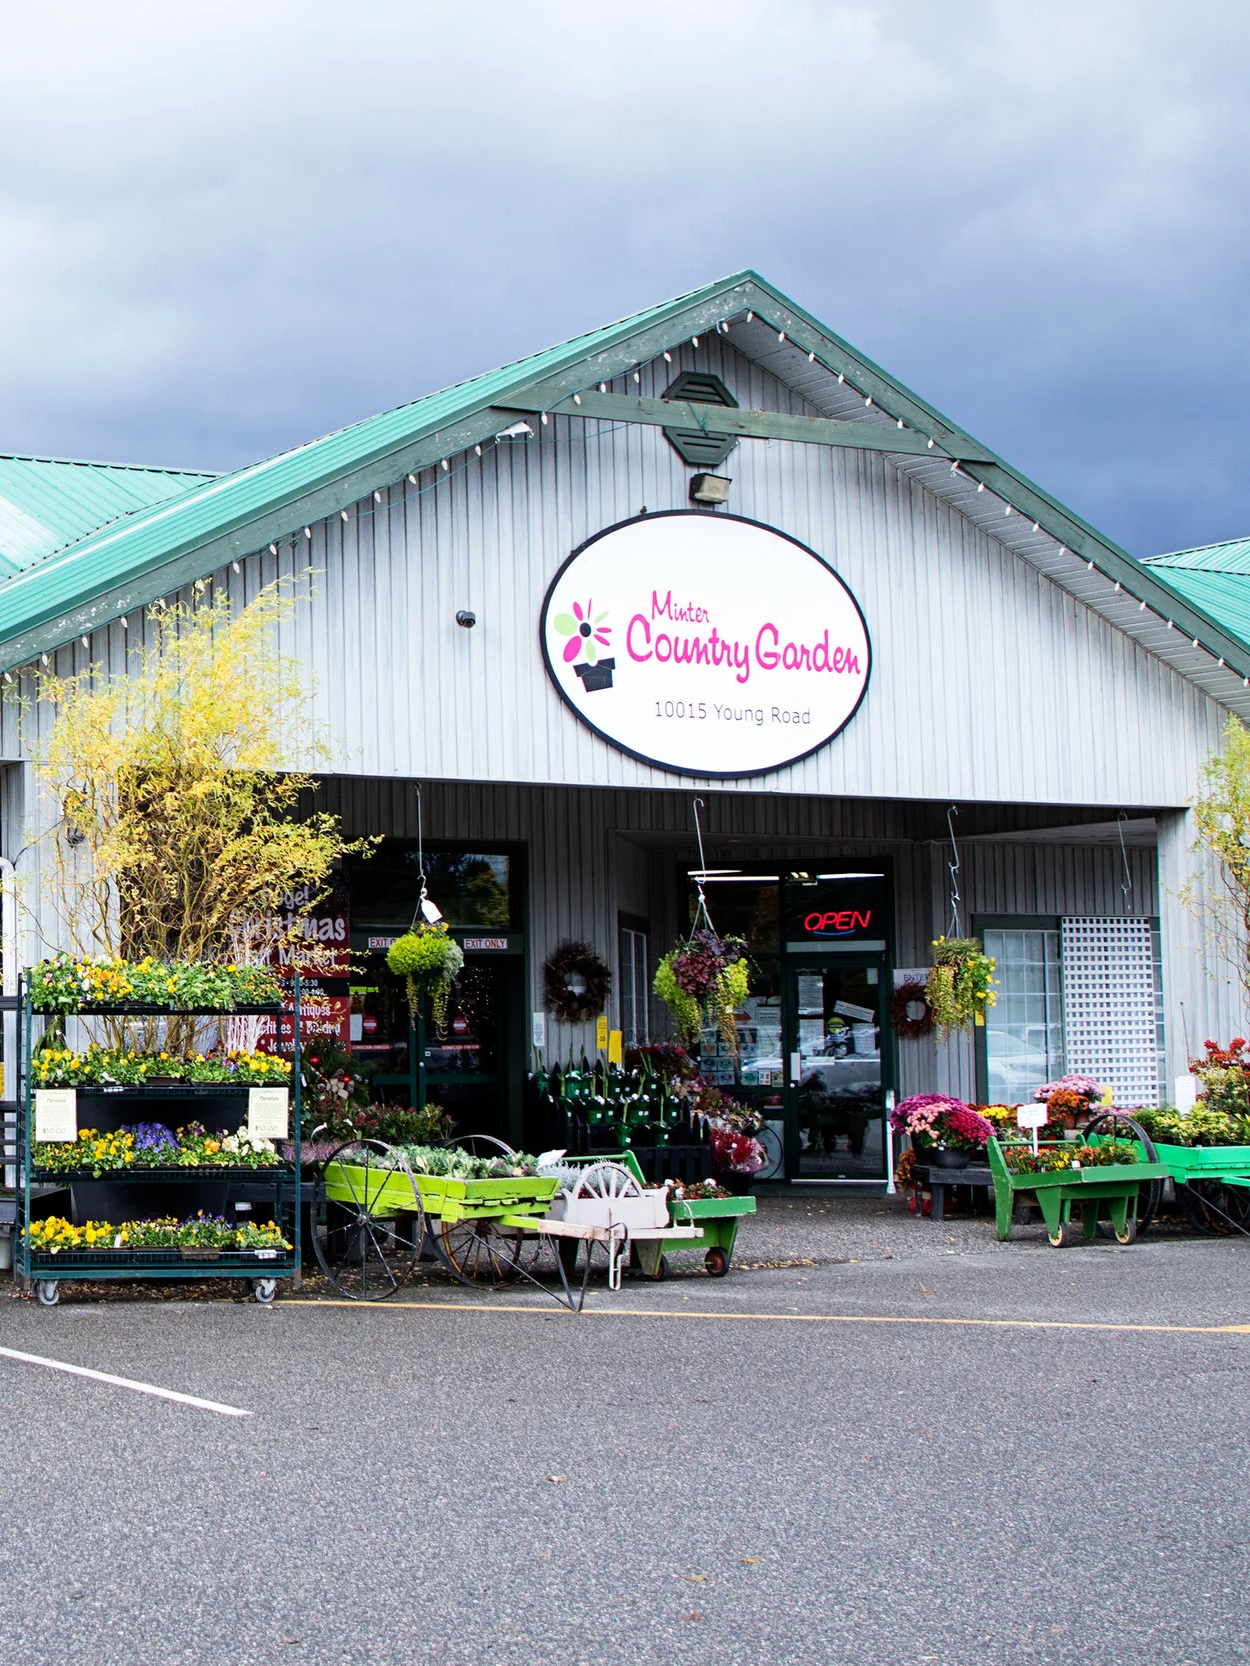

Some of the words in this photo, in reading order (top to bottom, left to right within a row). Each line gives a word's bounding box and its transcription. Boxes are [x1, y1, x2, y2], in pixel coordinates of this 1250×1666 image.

[651, 590, 710, 623] Minter
[626, 613, 750, 684] Country
[755, 622, 861, 675] Garden
[655, 701, 707, 719] 10015
[714, 704, 764, 727] Young
[771, 707, 811, 725] Road
[803, 909, 871, 931] OPEN
[370, 938, 389, 948] EXIT
[465, 939, 484, 949] EXIT
[484, 939, 507, 949] ONLY
